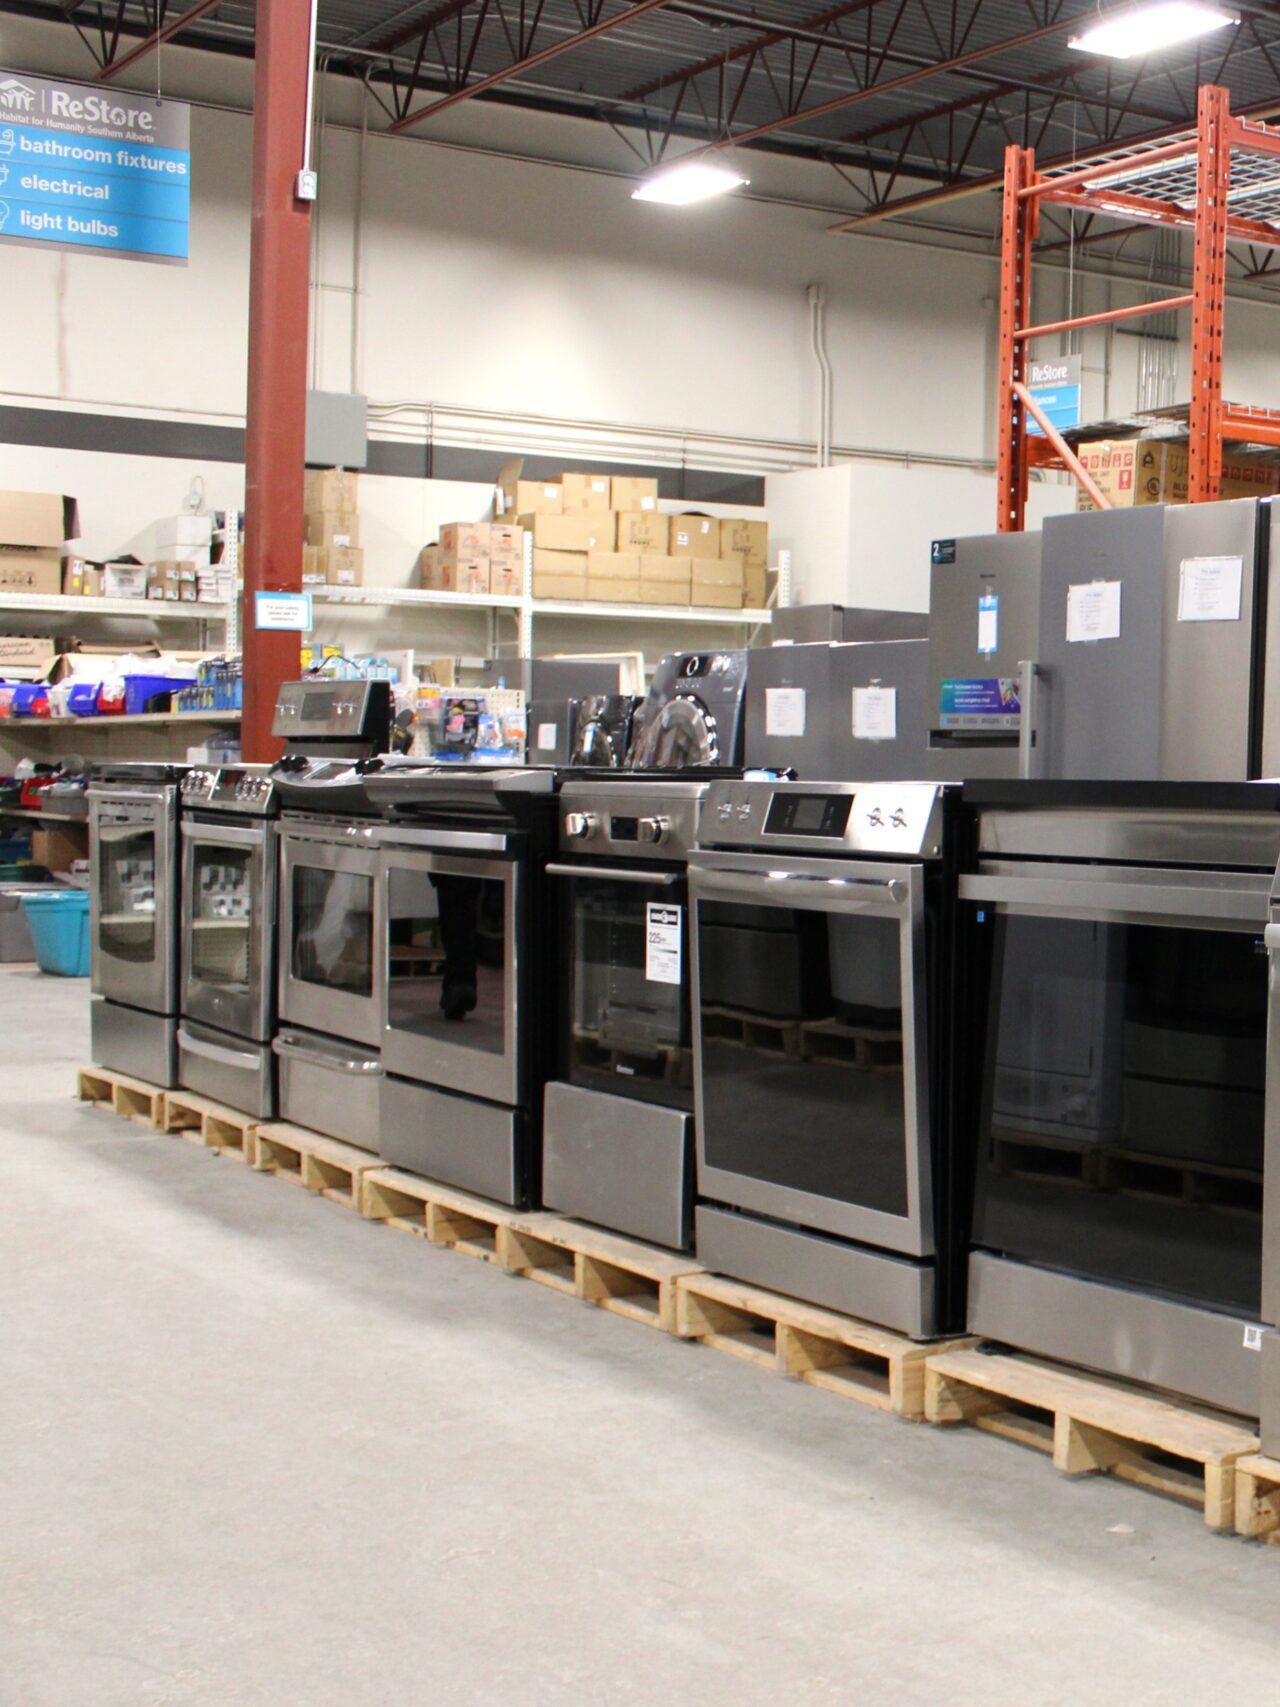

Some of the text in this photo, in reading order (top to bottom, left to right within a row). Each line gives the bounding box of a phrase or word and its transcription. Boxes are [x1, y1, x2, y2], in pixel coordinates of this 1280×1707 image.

[51, 90, 153, 130] ReStore
[0, 111, 154, 144] Habitat for Humanity Southern Alberta
[20, 136, 187, 175] bathroom fixtures
[20, 174, 109, 200] electrical
[20, 209, 120, 238] light bulbs
[1032, 364, 1068, 383] ReStore
